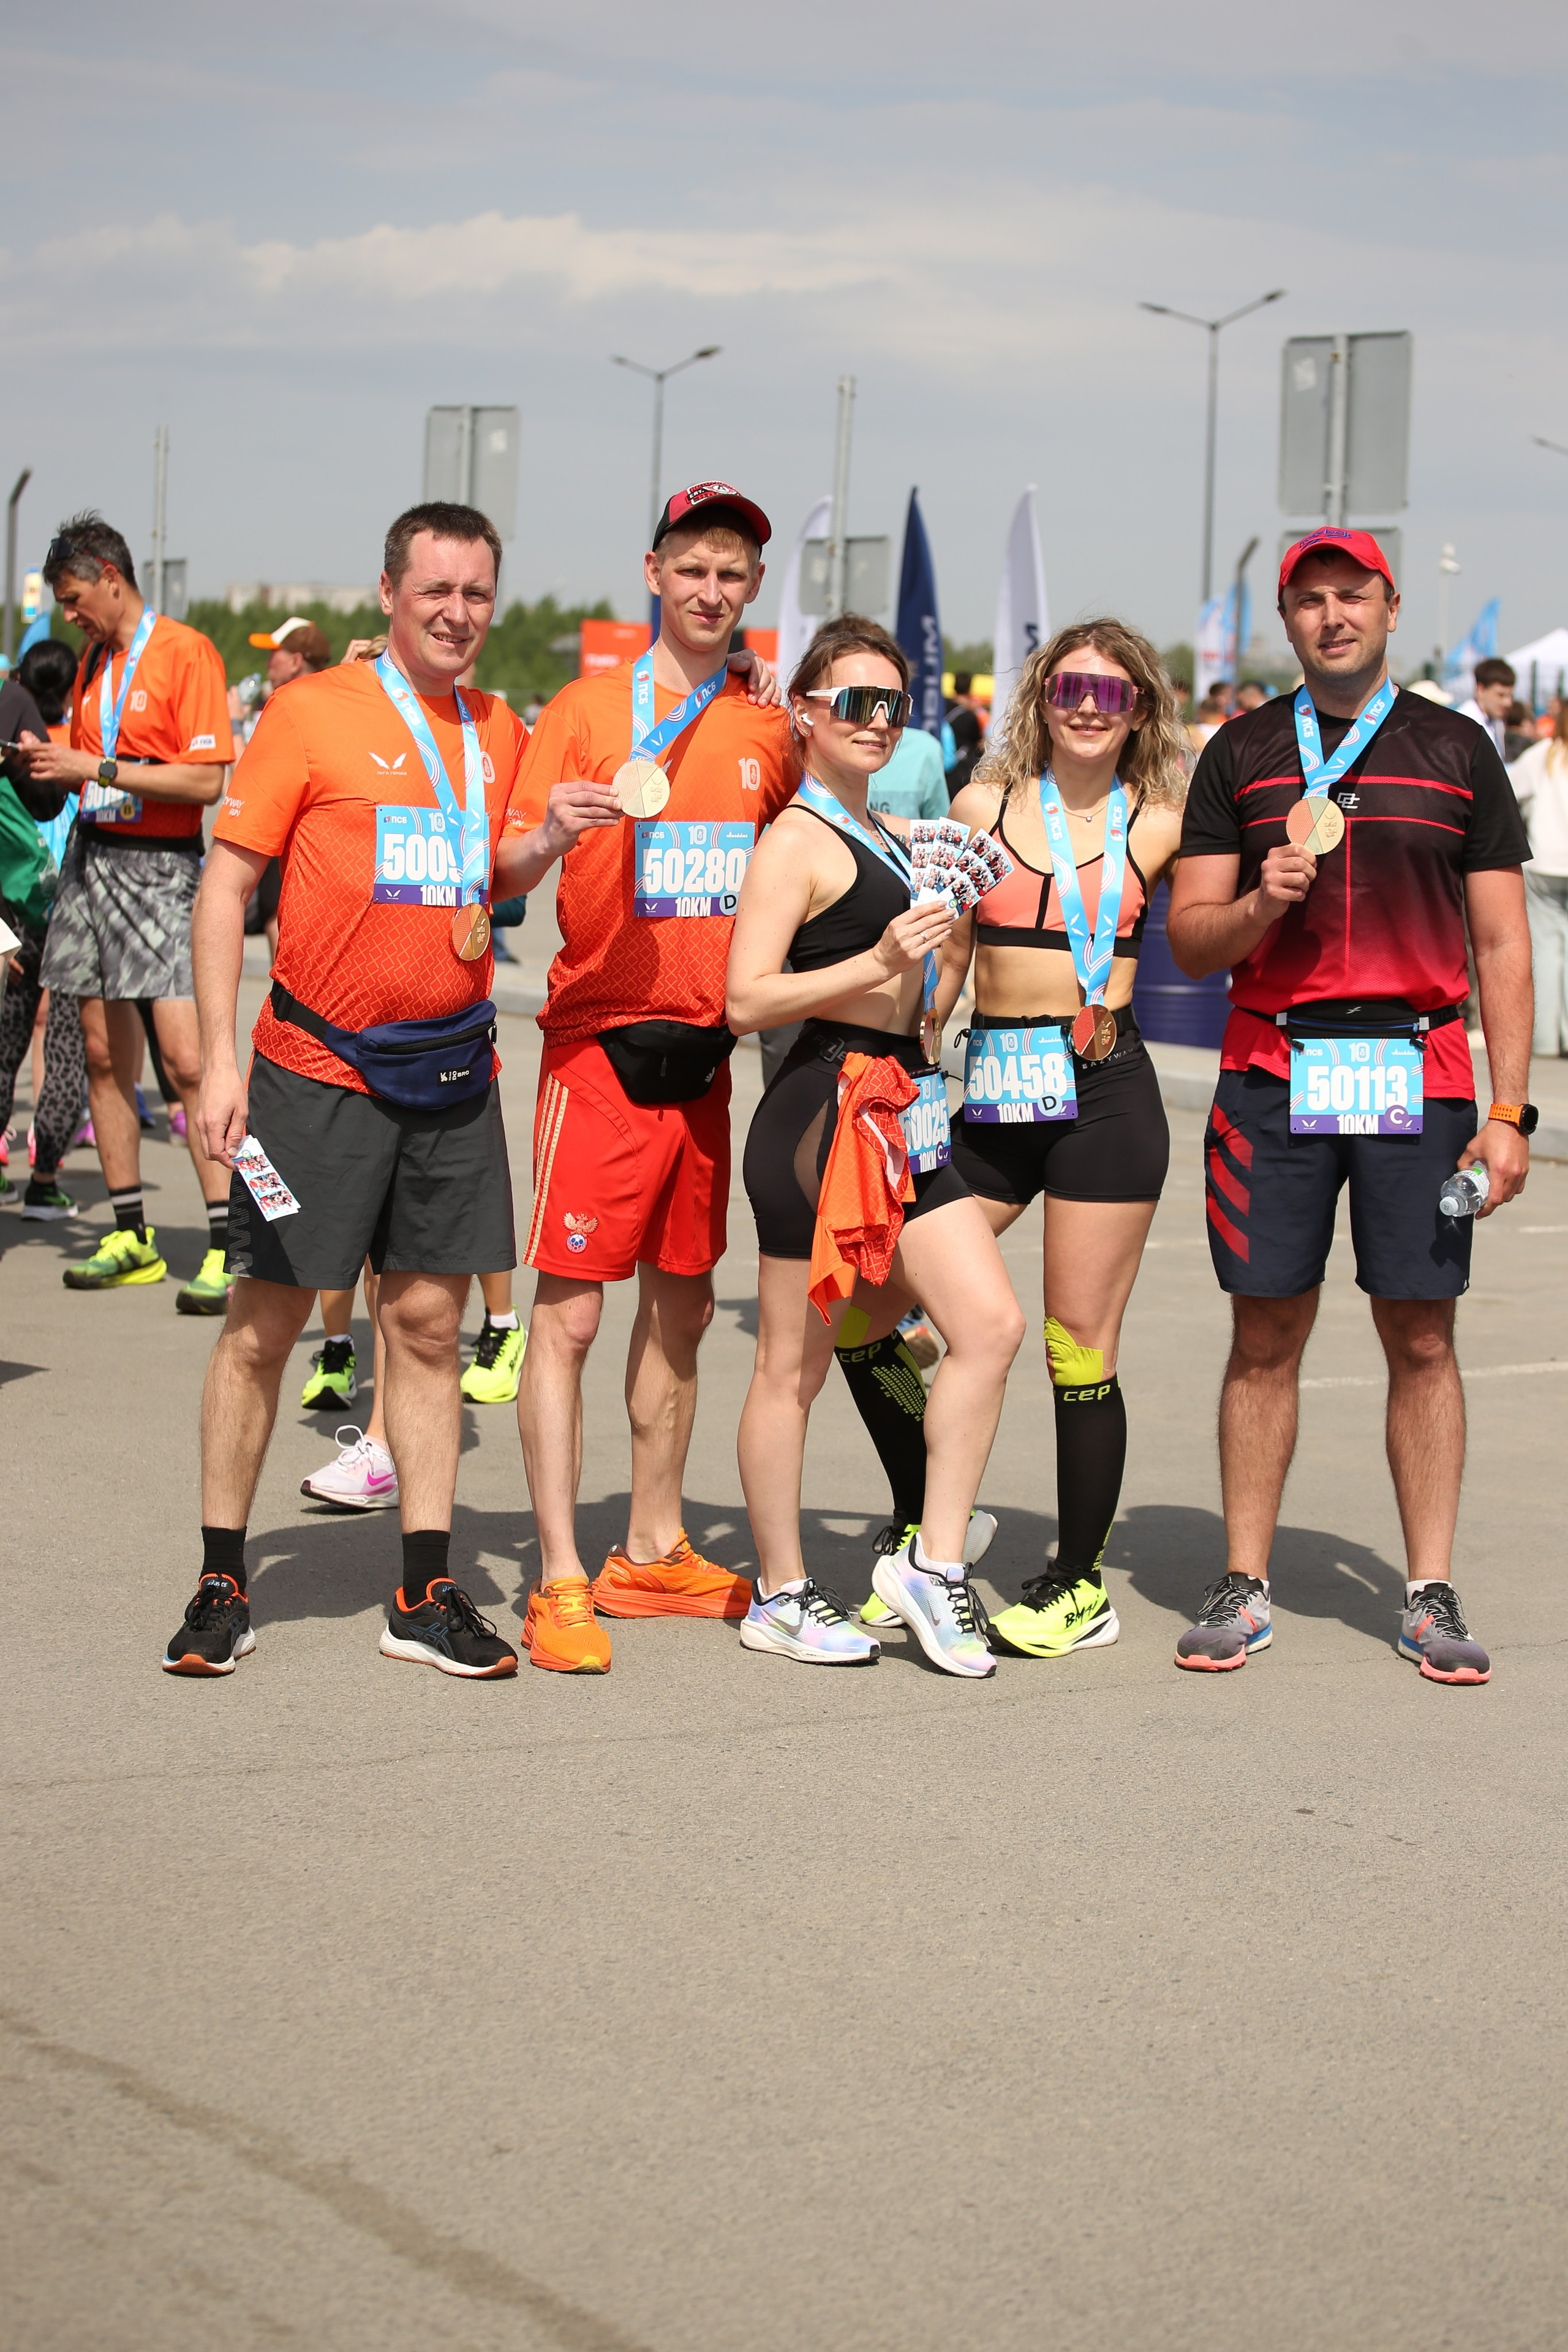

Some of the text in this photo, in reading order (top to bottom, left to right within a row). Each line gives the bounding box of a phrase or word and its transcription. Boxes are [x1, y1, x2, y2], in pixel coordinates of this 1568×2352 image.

[638, 683, 649, 705] ПСБ
[701, 681, 716, 699] ПСБ
[130, 690, 148, 712] 10
[1370, 699, 1385, 717] ПСБ
[401, 703, 421, 726] ПСБ
[1302, 717, 1314, 738] ПСБ
[738, 758, 760, 791] 10
[228, 808, 241, 817] RUN
[428, 812, 446, 832] 10
[507, 817, 524, 827] RUN
[1112, 805, 1122, 827] ПСБ
[688, 825, 707, 845] 10
[848, 824, 870, 845] ПСБ
[1049, 816, 1063, 840] ПСБ
[643, 848, 747, 894] 50280
[420, 884, 456, 907] 10KM
[724, 894, 736, 910] D
[675, 897, 712, 917] 10KM
[1000, 1033, 1018, 1052] 10
[1349, 1042, 1370, 1062] 10
[970, 1052, 1067, 1100] 50458
[921, 1079, 931, 1100] 10
[1307, 1065, 1408, 1111] 50113
[997, 1102, 1035, 1123] 10KM
[1041, 1096, 1057, 1110] D
[898, 1098, 949, 1153] 50025
[1337, 1114, 1379, 1134] 10KM
[1390, 1109, 1405, 1125] C
[919, 1150, 937, 1173] 10KM
[937, 1145, 943, 1160] C
[839, 1342, 881, 1363] cep
[1063, 1384, 1110, 1401] cep
